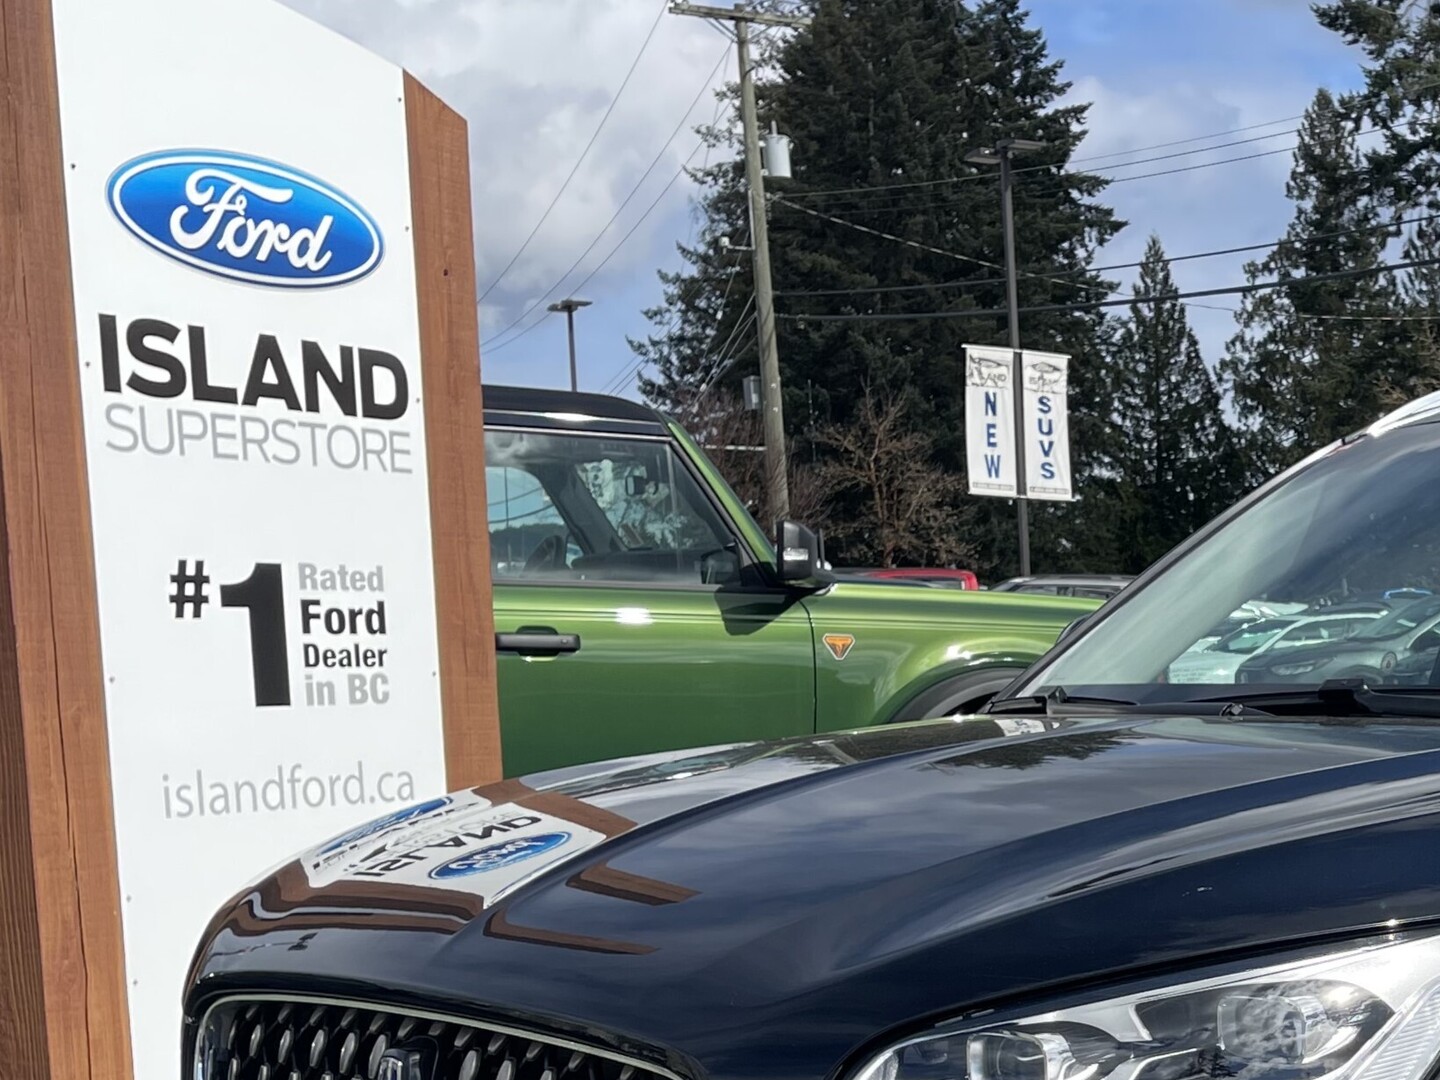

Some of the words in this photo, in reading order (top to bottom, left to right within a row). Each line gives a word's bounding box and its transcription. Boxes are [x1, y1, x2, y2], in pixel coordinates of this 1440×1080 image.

[169, 168, 334, 272] Ford
[98, 313, 410, 421] ISLAND
[104, 402, 414, 475] SUPERSTORE
[984, 391, 1001, 479] NEW
[1037, 395, 1056, 480] SUVS
[298, 562, 385, 593] Rated
[168, 559, 292, 708] #1
[300, 598, 388, 635] Ford
[303, 643, 388, 668] Dealer
[304, 674, 336, 707] in
[347, 672, 391, 705] BC
[161, 760, 416, 820] islandford.ca
